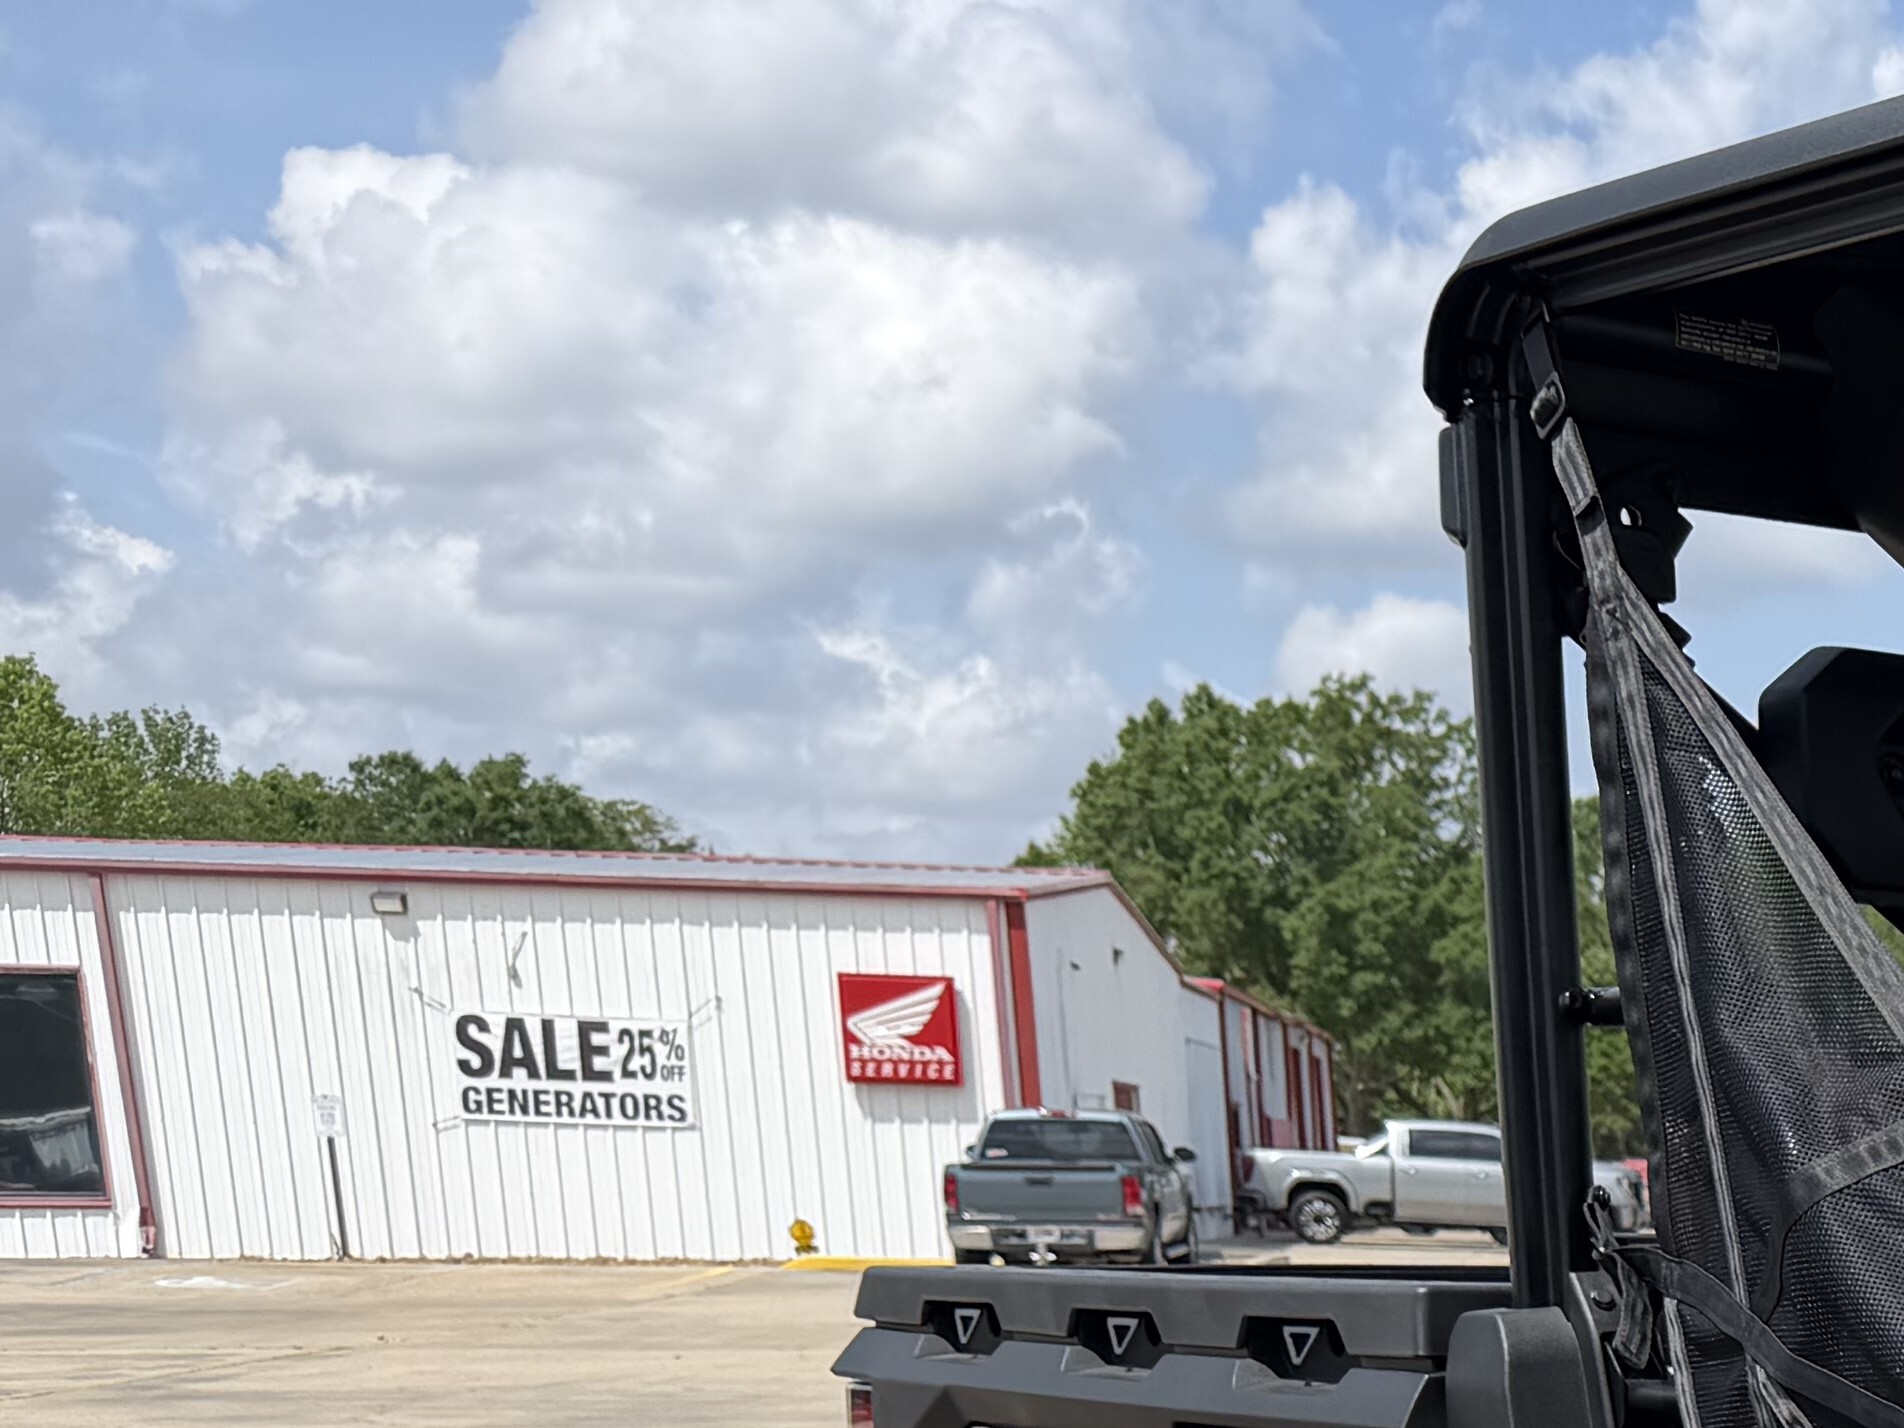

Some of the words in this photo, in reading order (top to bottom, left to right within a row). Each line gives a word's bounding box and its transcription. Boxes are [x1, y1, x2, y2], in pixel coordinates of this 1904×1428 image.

[455, 1014, 615, 1083] SALE
[617, 1027, 685, 1081] 25%
[848, 1042, 955, 1061] HONDA
[660, 1065, 687, 1083] OFF
[850, 1061, 955, 1080] SERVICE
[462, 1086, 688, 1122] GENERATORS
